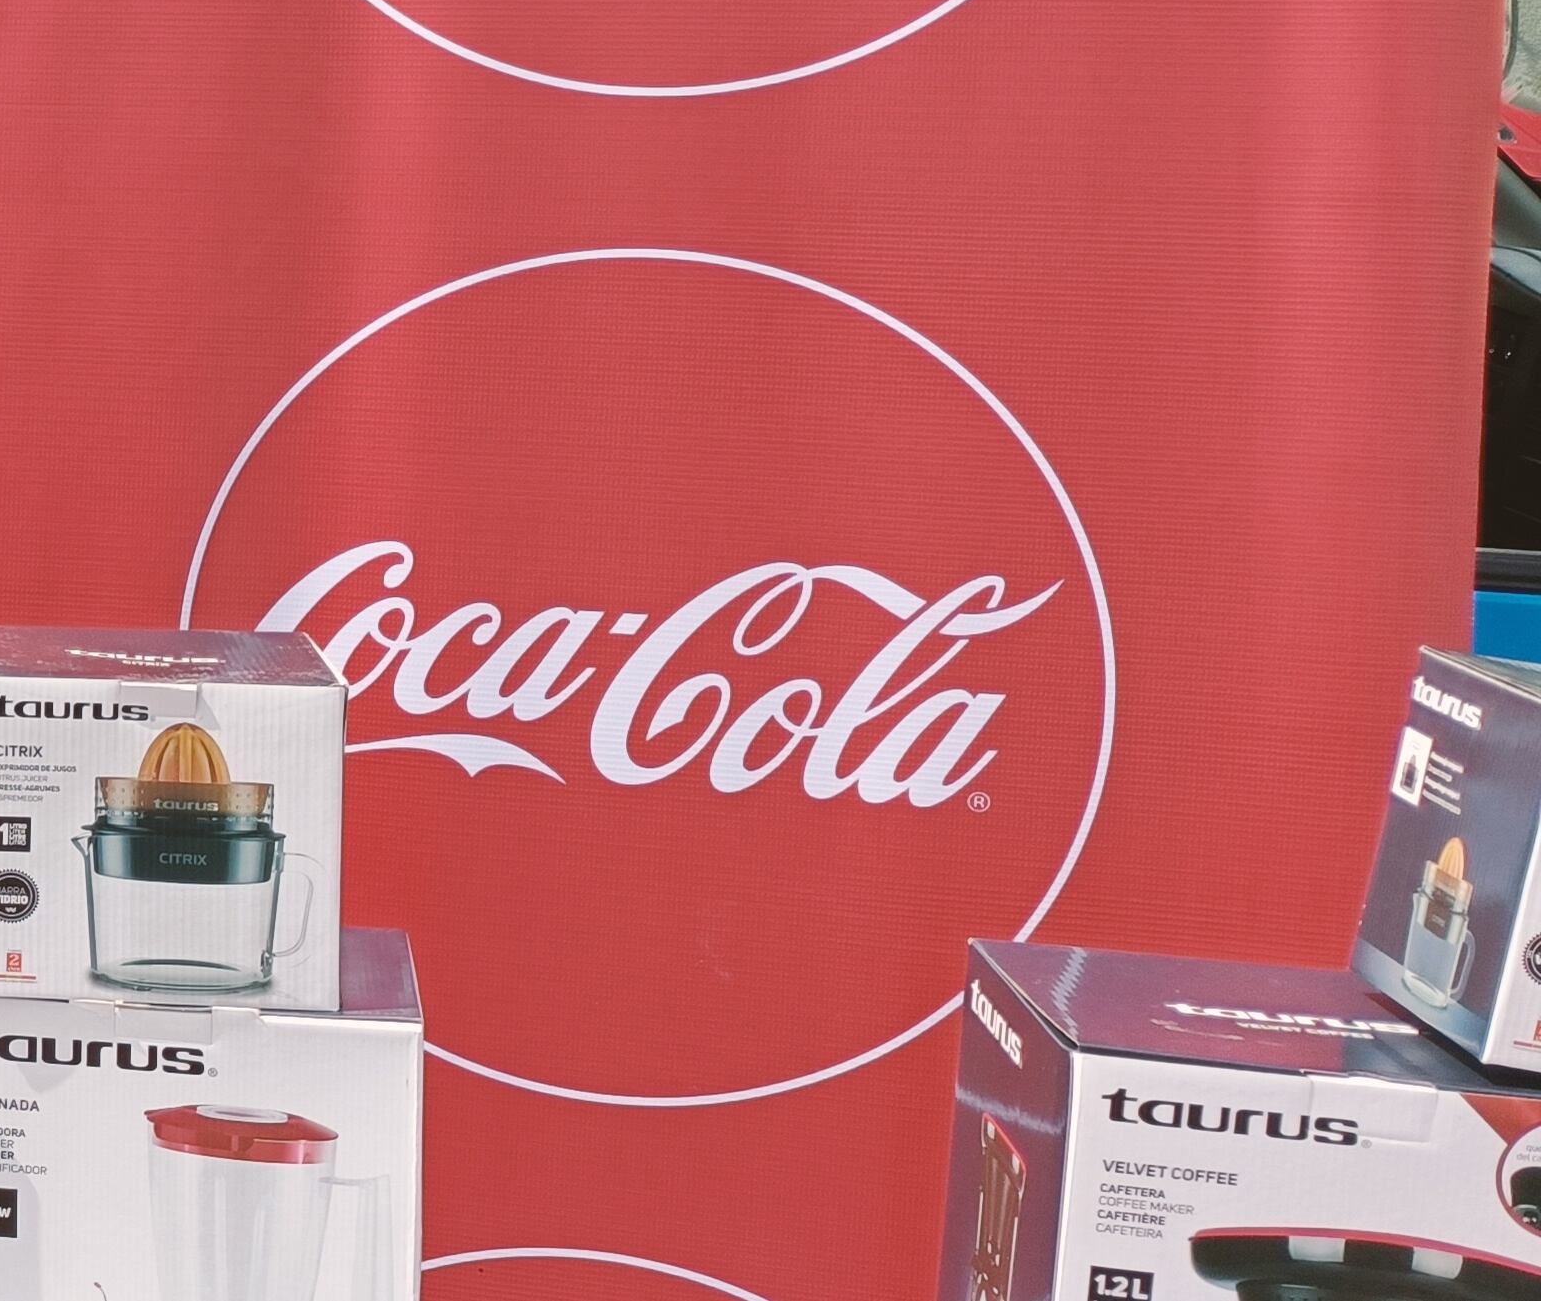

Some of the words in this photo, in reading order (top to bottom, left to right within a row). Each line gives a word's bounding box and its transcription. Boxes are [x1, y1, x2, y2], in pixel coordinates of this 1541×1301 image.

[1412, 675, 1481, 731] taurus
[52, 765, 77, 773] JUGOS
[153, 798, 219, 811] taurus
[159, 852, 207, 866] CITRIX
[970, 979, 1022, 1069] taurus
[1164, 1002, 1420, 1035] taurus
[1101, 1087, 1359, 1146] taurus
[1103, 1159, 1168, 1178] VELVET
[1171, 1167, 1238, 1186] COFFEE
[1100, 1183, 1165, 1199] CAFETERA
[1098, 1196, 1146, 1211] COFFEE
[1150, 1201, 1195, 1215] MAKER
[1097, 1209, 1166, 1226] CAFETIÈRE
[1096, 1222, 1163, 1239] CAFETEIRA
